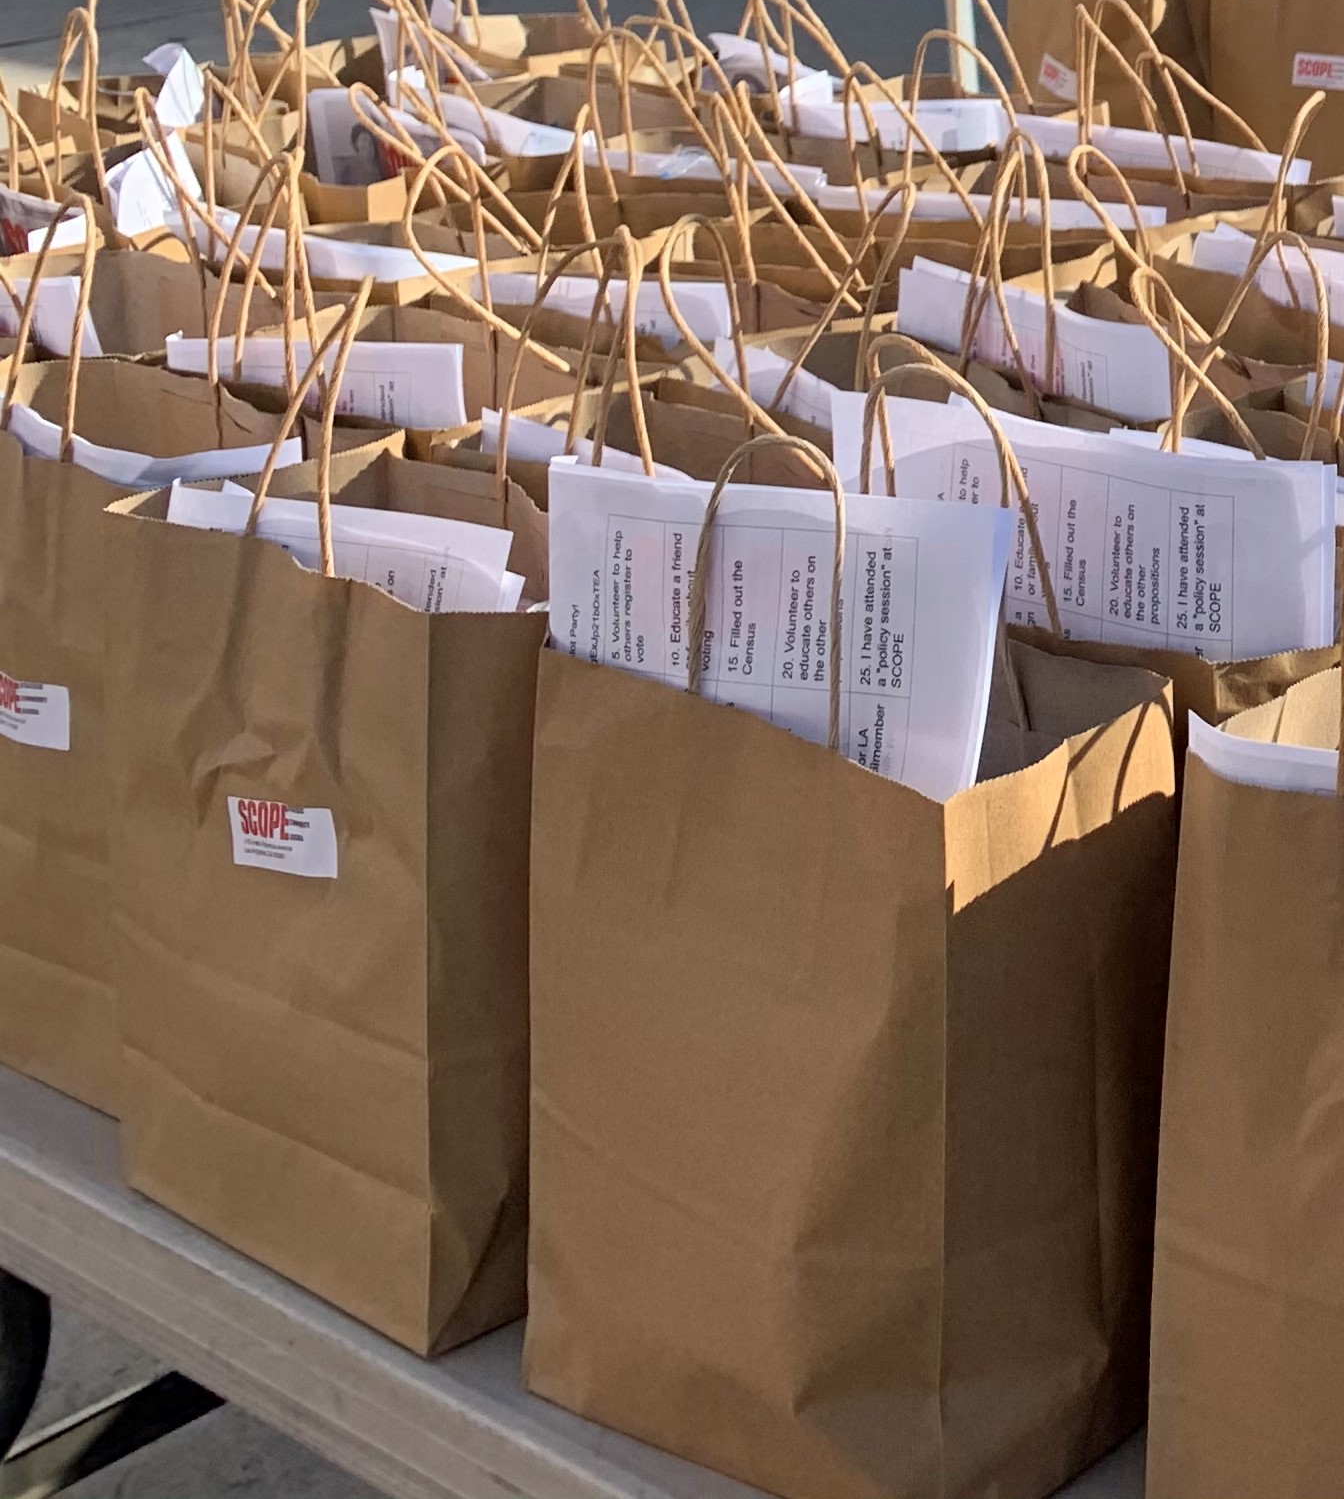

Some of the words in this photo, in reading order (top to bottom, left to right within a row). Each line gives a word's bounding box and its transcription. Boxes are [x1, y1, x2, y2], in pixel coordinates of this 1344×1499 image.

[961, 458, 971, 484] help
[1068, 500, 1076, 520] the
[1114, 515, 1122, 528] to
[1128, 504, 1135, 521] on
[1196, 504, 1206, 516] at
[612, 530, 623, 558] help
[1014, 518, 1025, 570] Educate
[1068, 523, 1076, 542] out
[1125, 527, 1134, 566] others
[1179, 506, 1190, 562] attended
[1194, 519, 1204, 574] session"
[612, 563, 620, 575] to
[625, 548, 632, 558] to
[672, 533, 682, 572] friend
[808, 555, 816, 574] on
[884, 547, 892, 560] at
[1064, 546, 1074, 580] Filled
[1110, 532, 1121, 592] Volunteer
[734, 559, 743, 582] the
[791, 570, 800, 585] to
[866, 550, 876, 612] attended
[1014, 574, 1023, 590] 10.
[1076, 558, 1086, 607] Census
[1138, 565, 1146, 598] other
[1151, 548, 1160, 625] propositions
[1178, 568, 1188, 599] have
[624, 564, 633, 616] register
[733, 584, 743, 606] out
[804, 582, 815, 621] others
[880, 564, 892, 624] session"
[1028, 582, 1035, 595] or
[1063, 588, 1072, 603] 15.
[1124, 571, 1133, 619] educate
[1193, 580, 1207, 620] "policy
[611, 579, 620, 643] Volunteer
[670, 587, 681, 644] Educate
[784, 586, 800, 654] Volunteer
[1109, 596, 1119, 617] 20.
[1136, 602, 1145, 622] the
[1176, 610, 1188, 630] 25.
[1209, 582, 1222, 633] SCOPE
[623, 620, 632, 662] others
[730, 610, 742, 648] Filled
[816, 619, 827, 657] other
[862, 617, 873, 652] have
[1195, 623, 1204, 632] a
[636, 635, 644, 664] vote
[728, 654, 738, 672] 15.
[742, 622, 756, 675] Census
[800, 625, 811, 681] educate
[876, 627, 890, 675] "policy
[891, 632, 904, 688] SCOPE
[782, 659, 794, 679] 20.
[814, 660, 824, 682] the
[860, 664, 872, 686] 25.
[858, 728, 868, 748] LA
[238, 798, 289, 840] SCOPE
